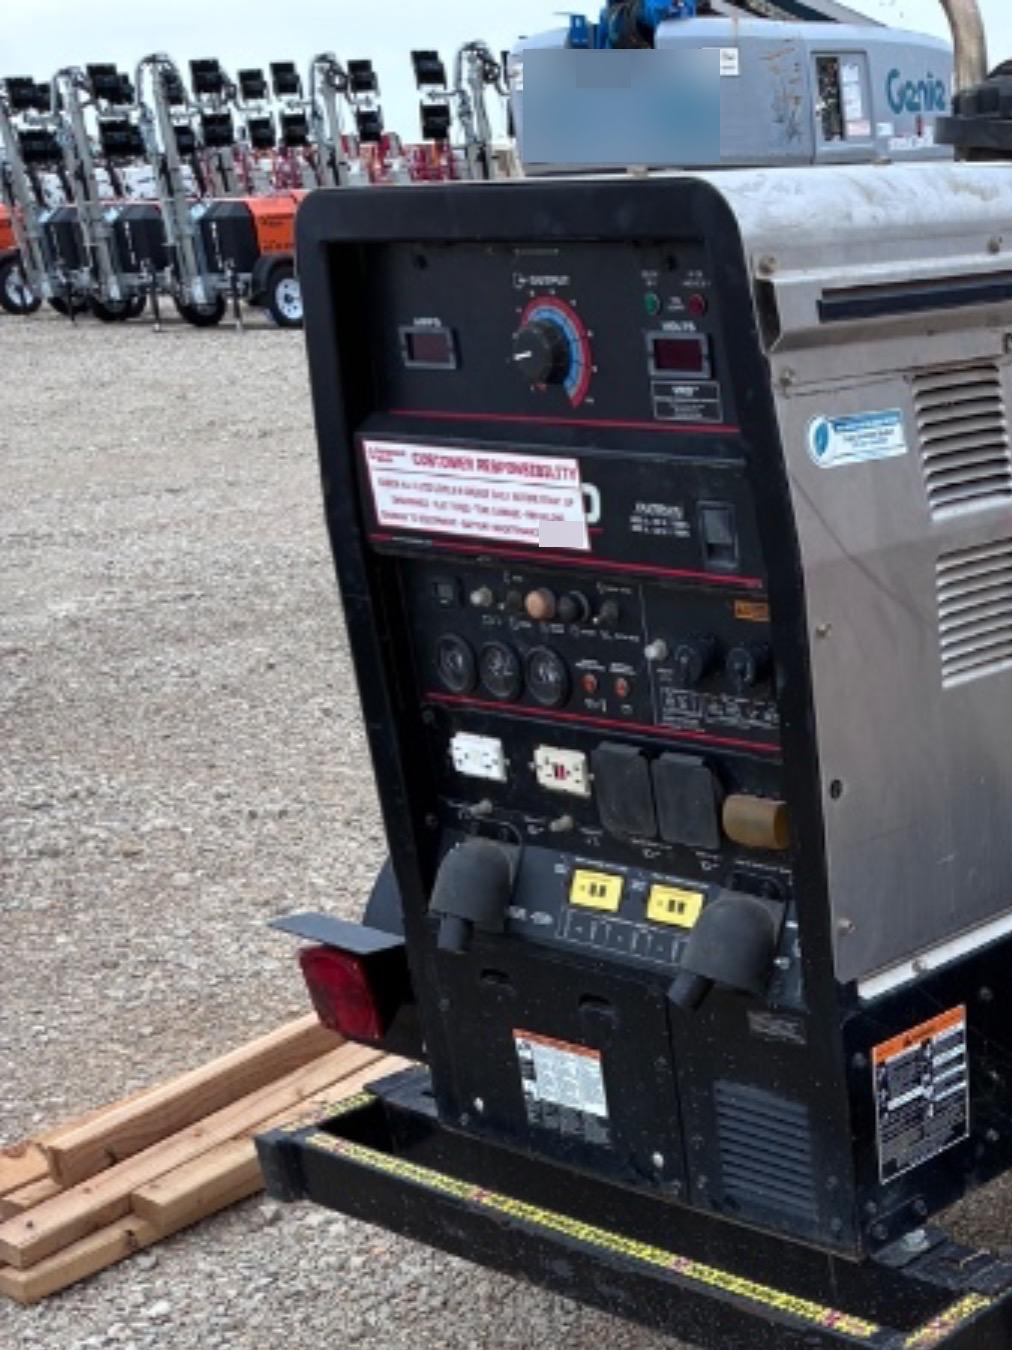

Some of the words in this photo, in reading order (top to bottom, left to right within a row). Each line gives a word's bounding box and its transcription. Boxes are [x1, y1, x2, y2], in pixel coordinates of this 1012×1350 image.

[886, 68, 946, 115] Genie
[411, 452, 474, 471] CUSTOMER
[476, 458, 577, 481] RESPONSIBILITY
